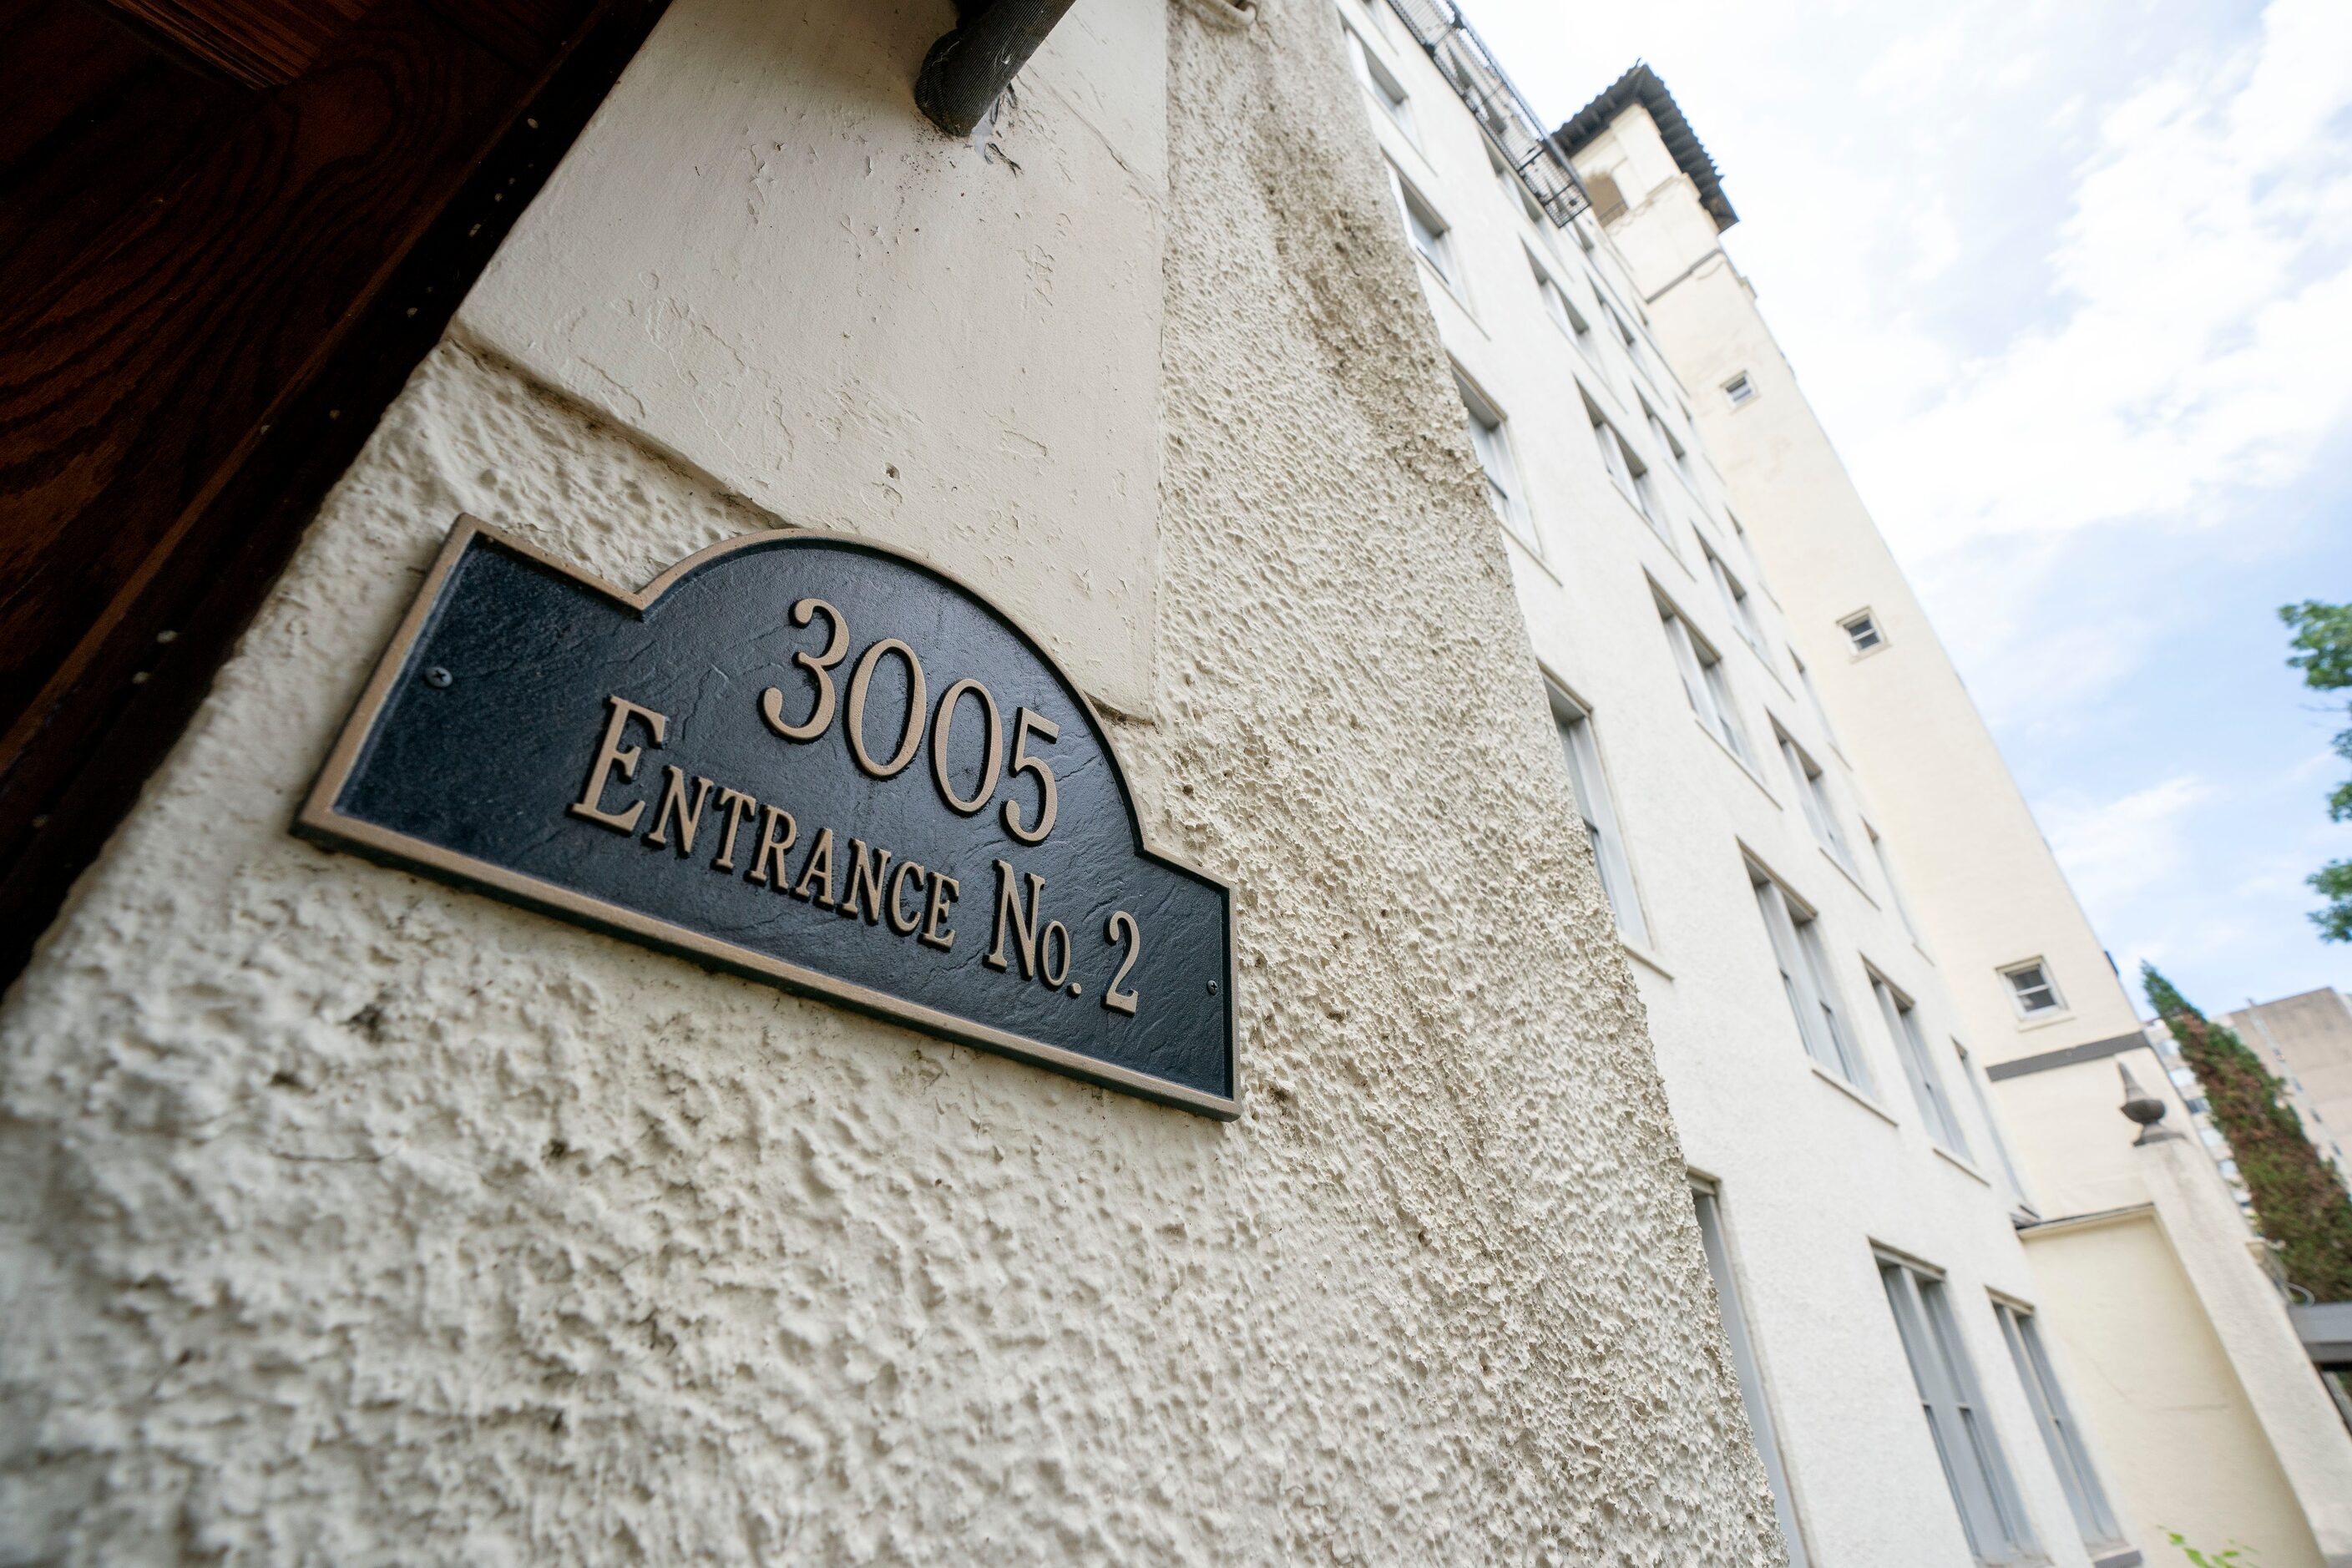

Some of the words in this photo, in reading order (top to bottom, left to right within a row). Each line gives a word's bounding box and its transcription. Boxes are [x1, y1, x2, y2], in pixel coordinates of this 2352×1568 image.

[571, 695, 959, 949] ENTRANCE
[1105, 910, 1140, 1014] 2
[763, 598, 1060, 842] 3005
